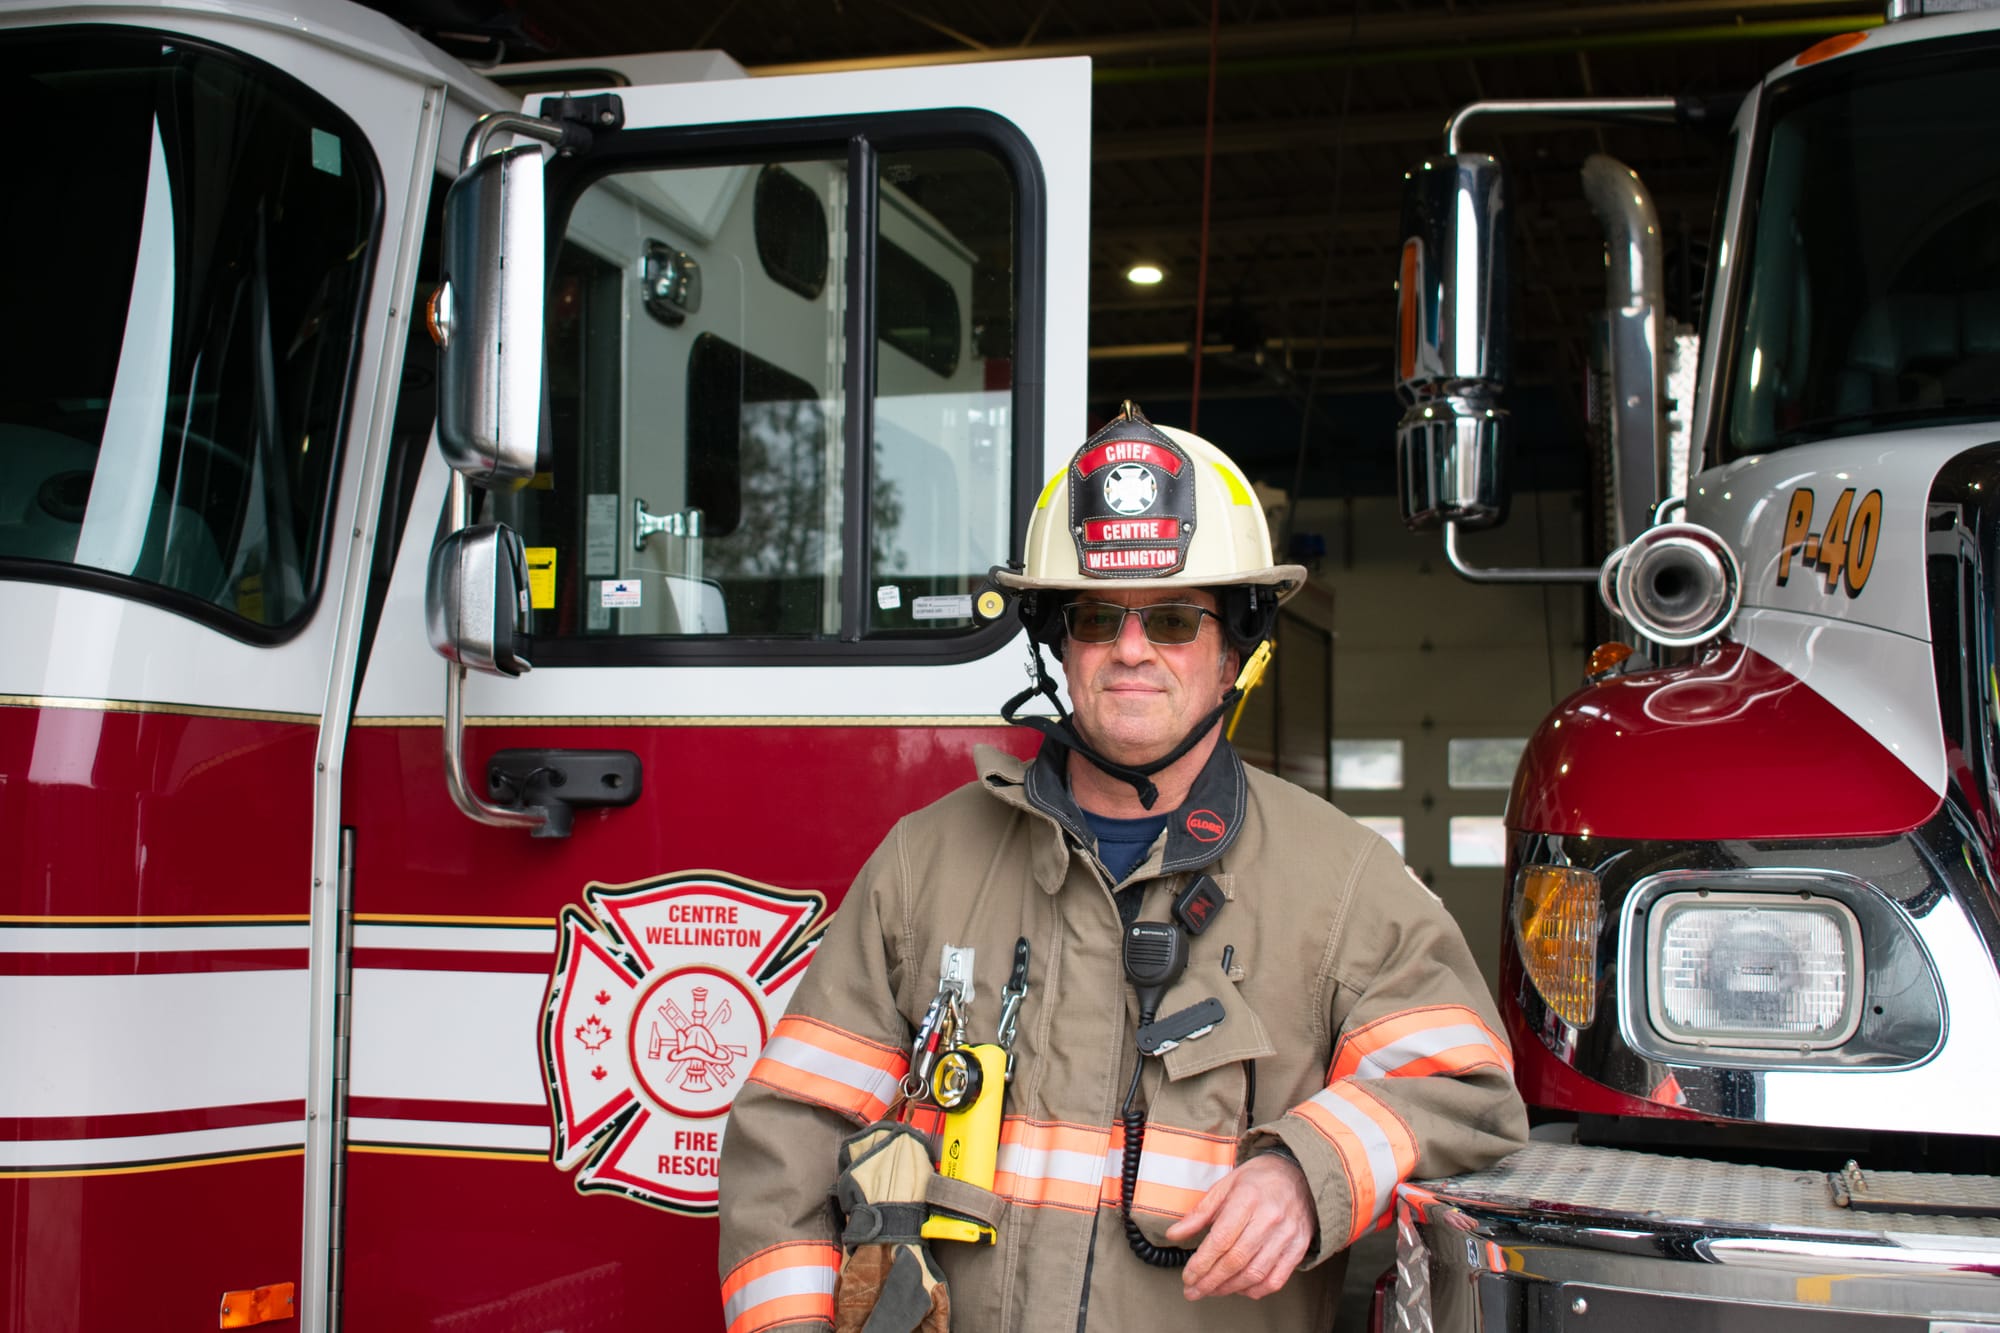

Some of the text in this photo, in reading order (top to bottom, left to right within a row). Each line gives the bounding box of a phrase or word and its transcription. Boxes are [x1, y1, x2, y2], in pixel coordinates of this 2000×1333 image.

[1105, 443, 1150, 462] CHIEF
[1102, 522, 1158, 541] CENTRE
[1776, 488, 1883, 600] P-40
[1089, 550, 1176, 569] WELLINGTON
[668, 904, 738, 924] CENTRE
[645, 926, 761, 948] WELLINGTON
[674, 1131, 718, 1152] FIRE
[657, 1154, 721, 1178] RESCU
